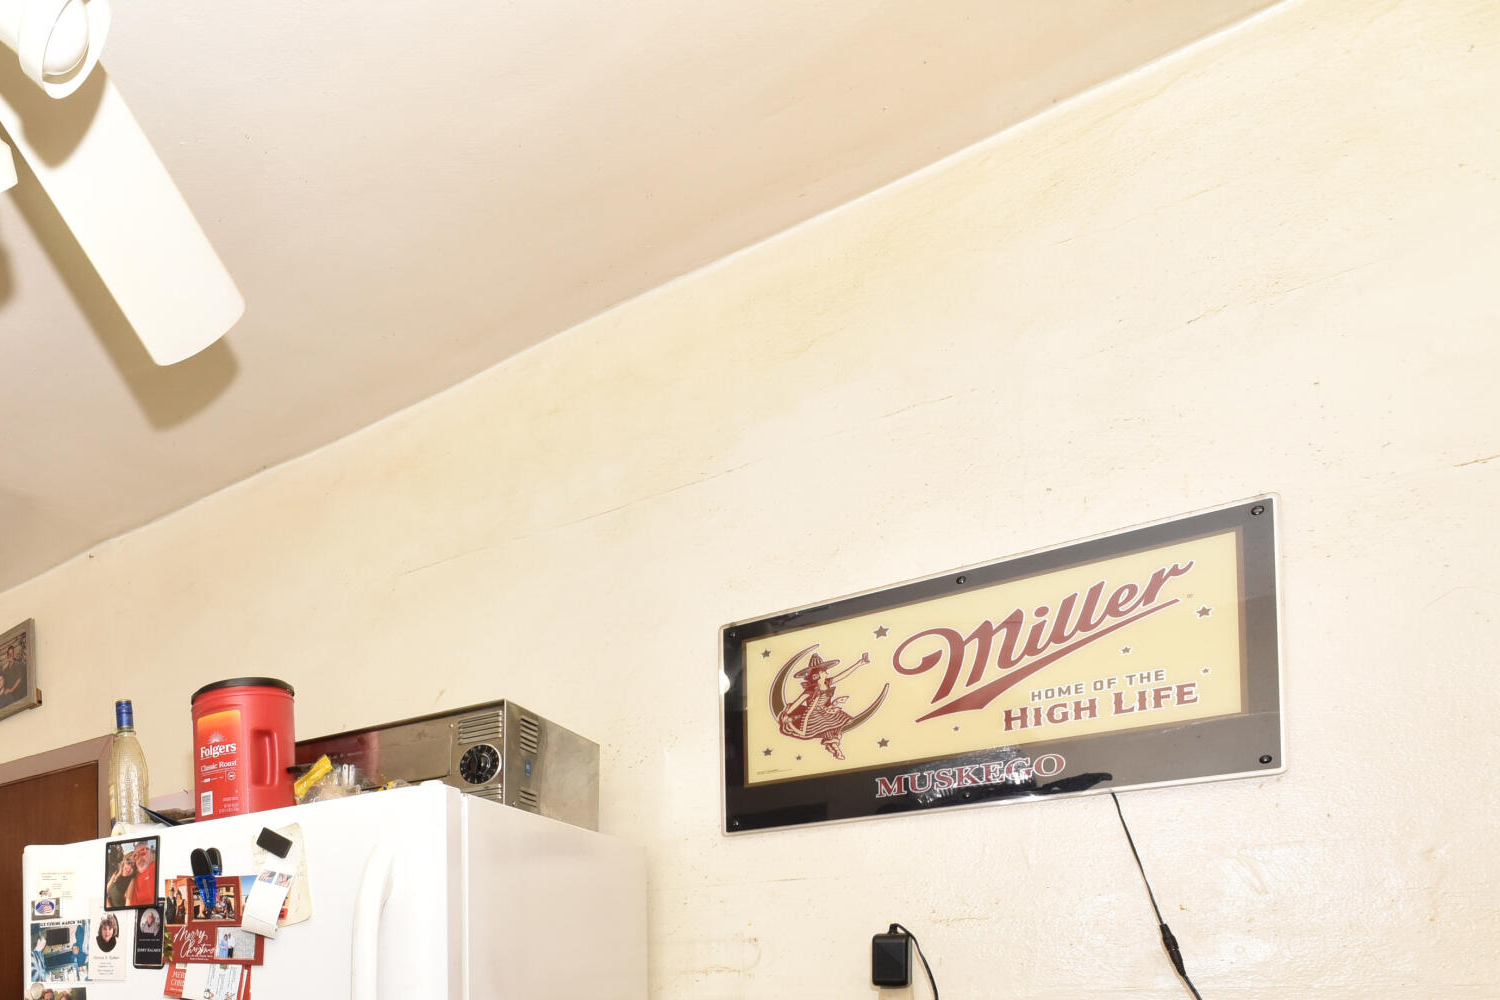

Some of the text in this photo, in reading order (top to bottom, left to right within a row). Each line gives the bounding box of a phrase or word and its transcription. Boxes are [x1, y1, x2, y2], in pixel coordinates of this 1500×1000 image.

[893, 559, 1195, 718] Miller
[1031, 669, 1165, 702] HOME OF THE
[1003, 682, 1198, 731] HIGH LIFE
[200, 742, 237, 758] Folgers
[201, 760, 237, 772] Classic Roast
[875, 753, 1066, 798] MUSKEGO
[173, 925, 208, 945] Merry
